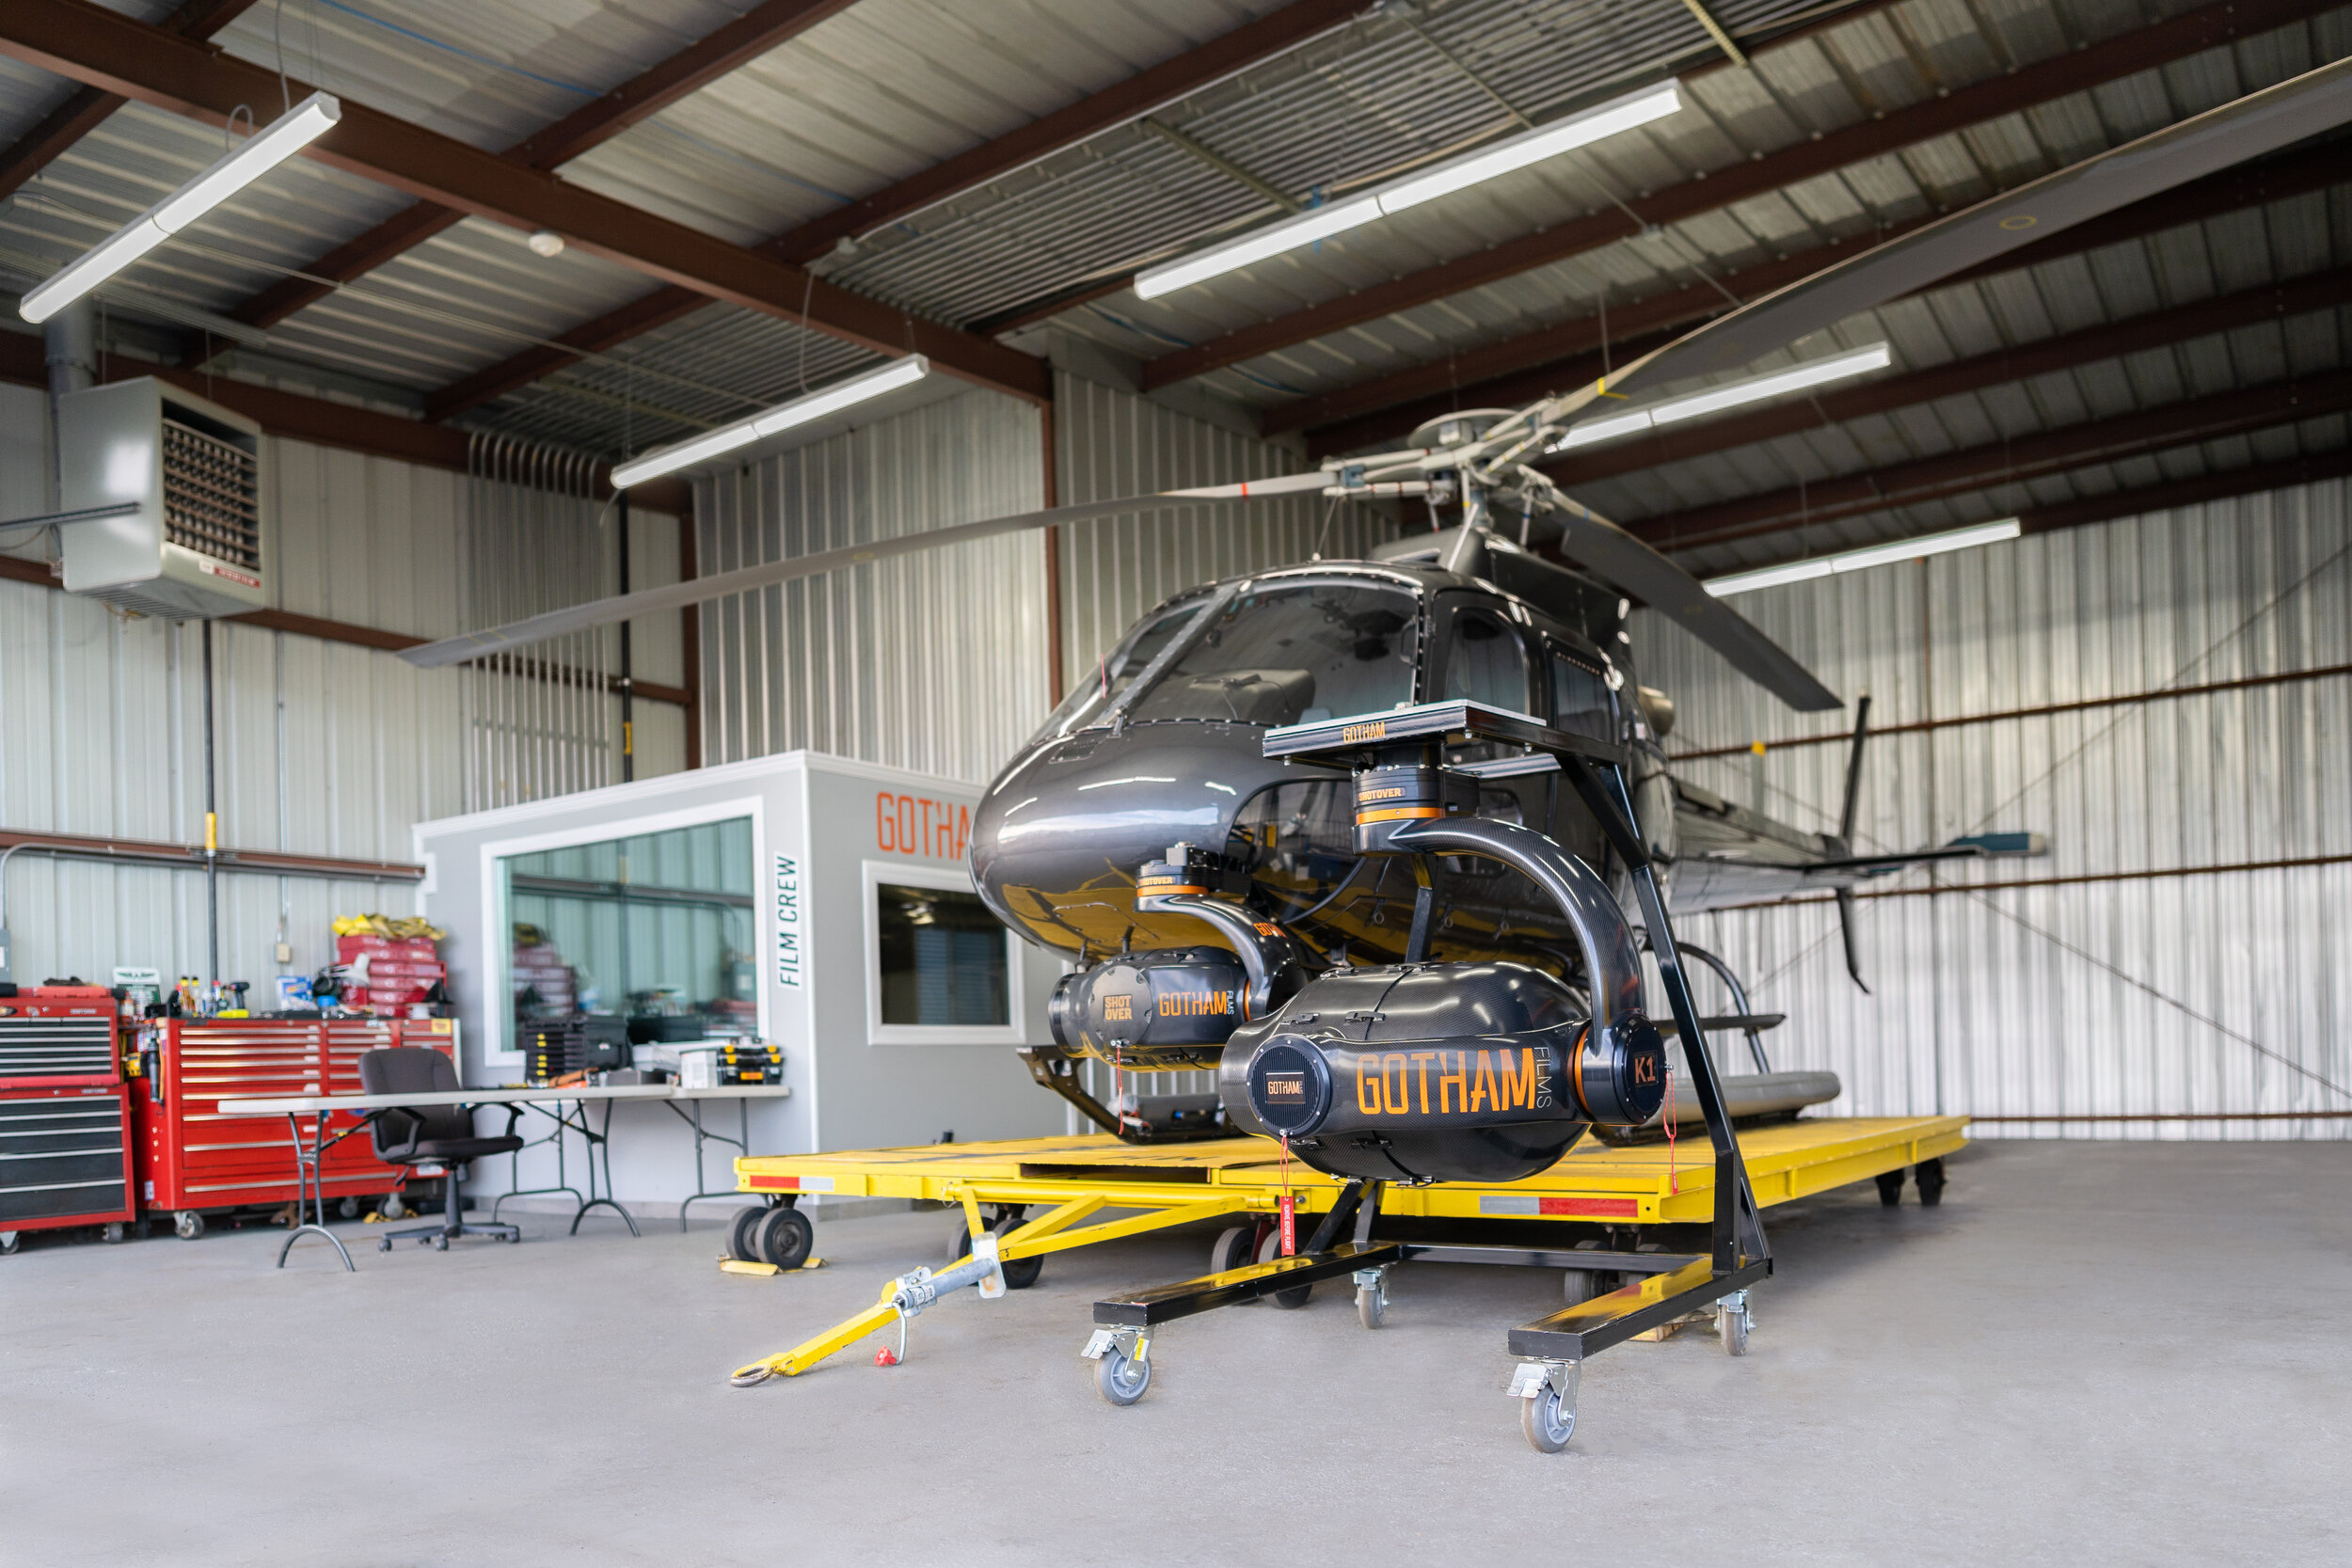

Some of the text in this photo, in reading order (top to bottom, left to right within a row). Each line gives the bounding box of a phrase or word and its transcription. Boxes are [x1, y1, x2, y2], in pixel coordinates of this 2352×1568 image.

[1343, 721, 1386, 744] GOTHAM
[1358, 787, 1402, 801] SHOTOVER
[877, 791, 975, 862] GOTHA
[776, 856, 800, 987] FILM CREW
[1104, 995, 1132, 1008] SHOT
[1158, 990, 1228, 1017] GOTHAM
[1104, 1008, 1133, 1021] OVER
[1357, 1047, 1552, 1115] GOTHAM FILMS
[1634, 1055, 1656, 1084] K1
[1267, 1081, 1300, 1095] GOTHAM
